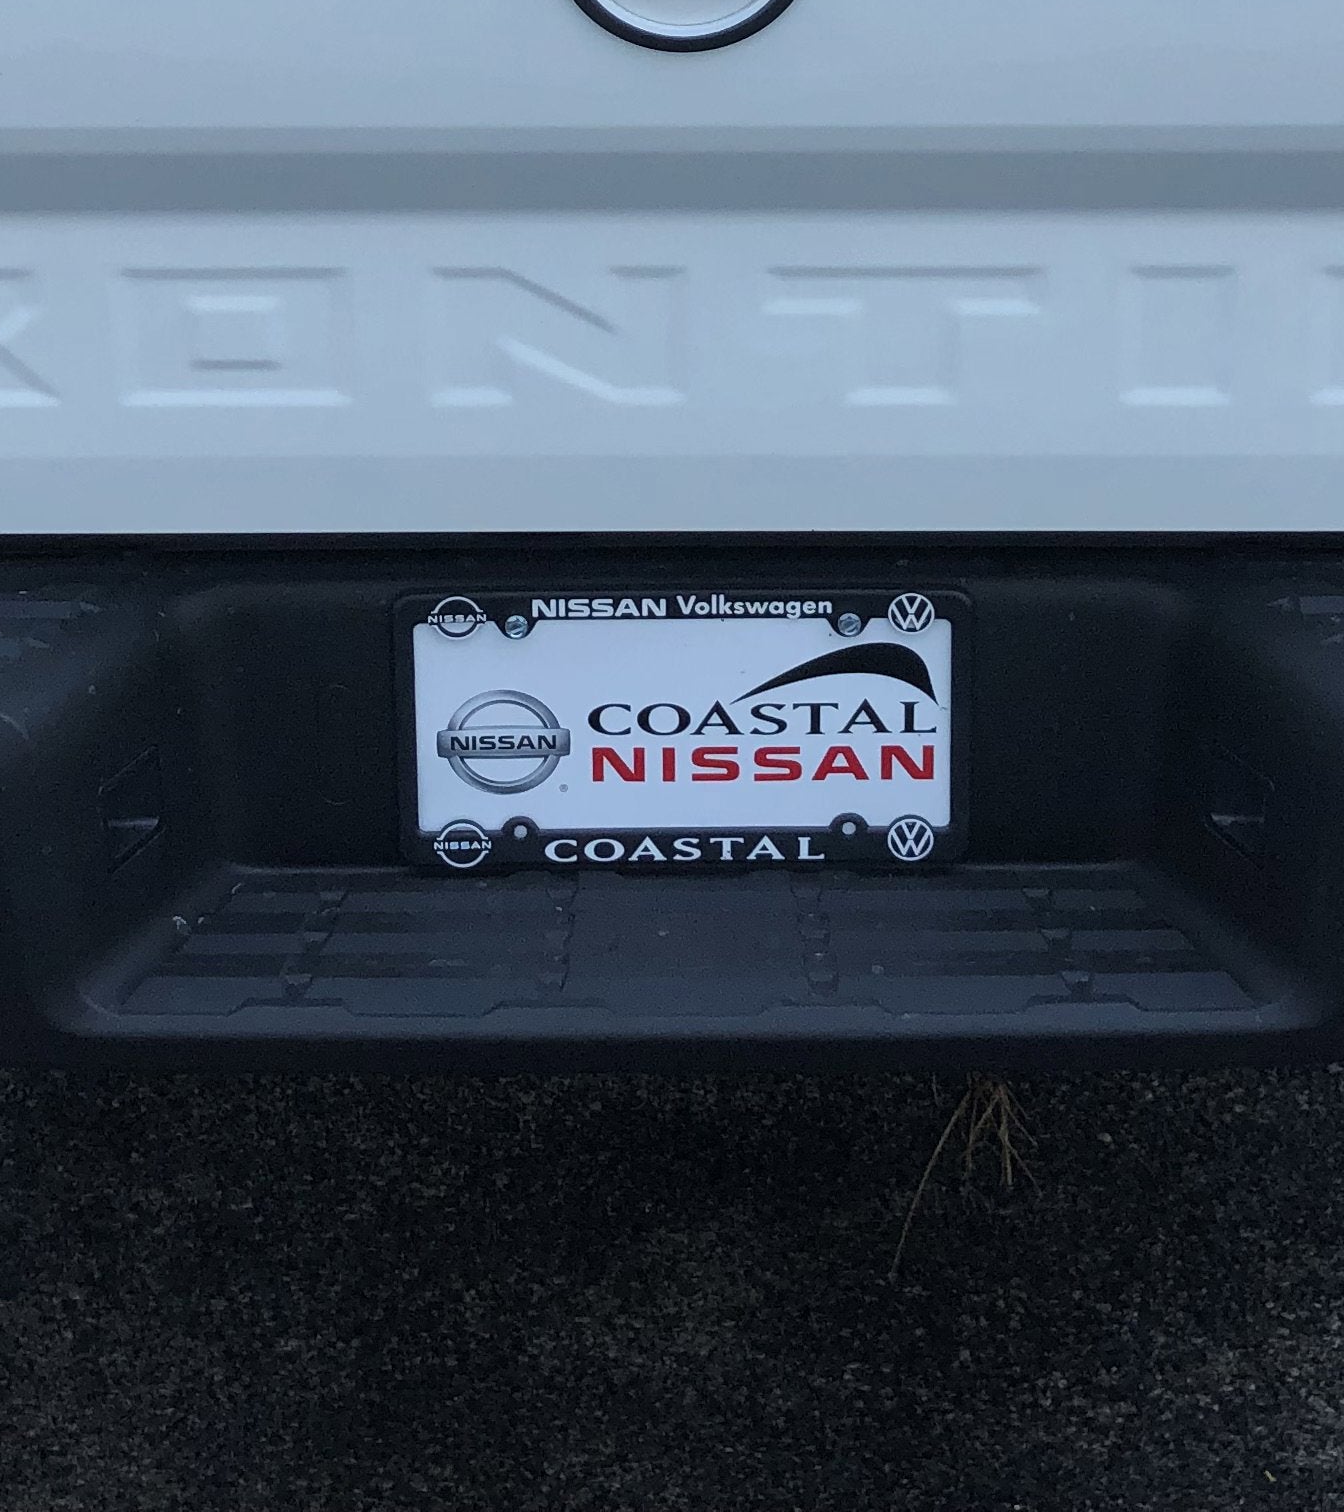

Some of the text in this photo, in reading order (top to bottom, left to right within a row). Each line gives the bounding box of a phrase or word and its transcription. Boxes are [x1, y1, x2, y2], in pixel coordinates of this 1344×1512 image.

[427, 613, 487, 625] NISSAN
[531, 594, 833, 619] NISSAN Volkswagen
[587, 699, 938, 737] COASTAL
[449, 733, 558, 752] NISSAN
[591, 744, 936, 782] NISSAN
[433, 840, 492, 850] NISSAN
[544, 836, 826, 863] COASTAL
